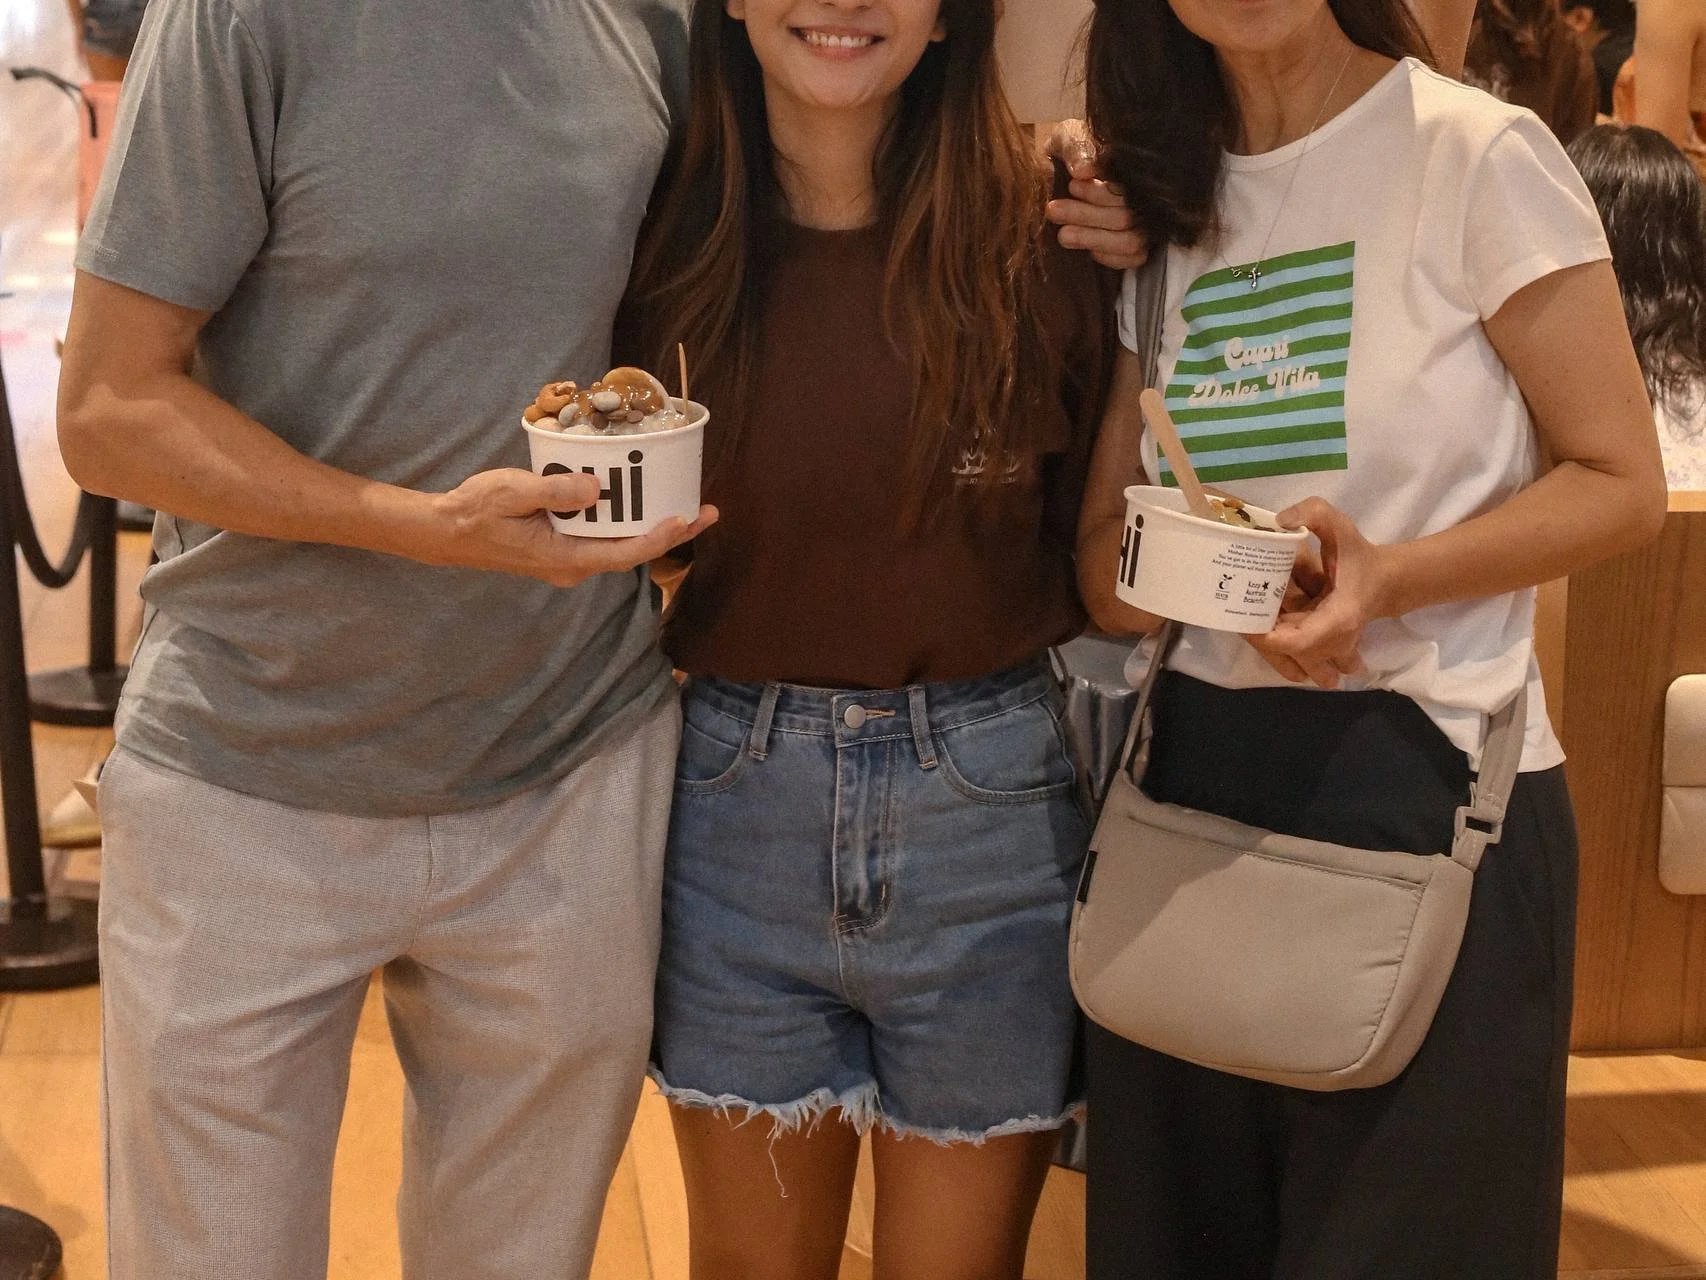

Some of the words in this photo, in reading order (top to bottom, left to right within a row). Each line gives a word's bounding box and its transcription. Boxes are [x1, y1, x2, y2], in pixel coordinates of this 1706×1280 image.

[1224, 335, 1289, 370] Capri
[1188, 373, 1261, 407] Dolce
[1267, 365, 1321, 399] Vita
